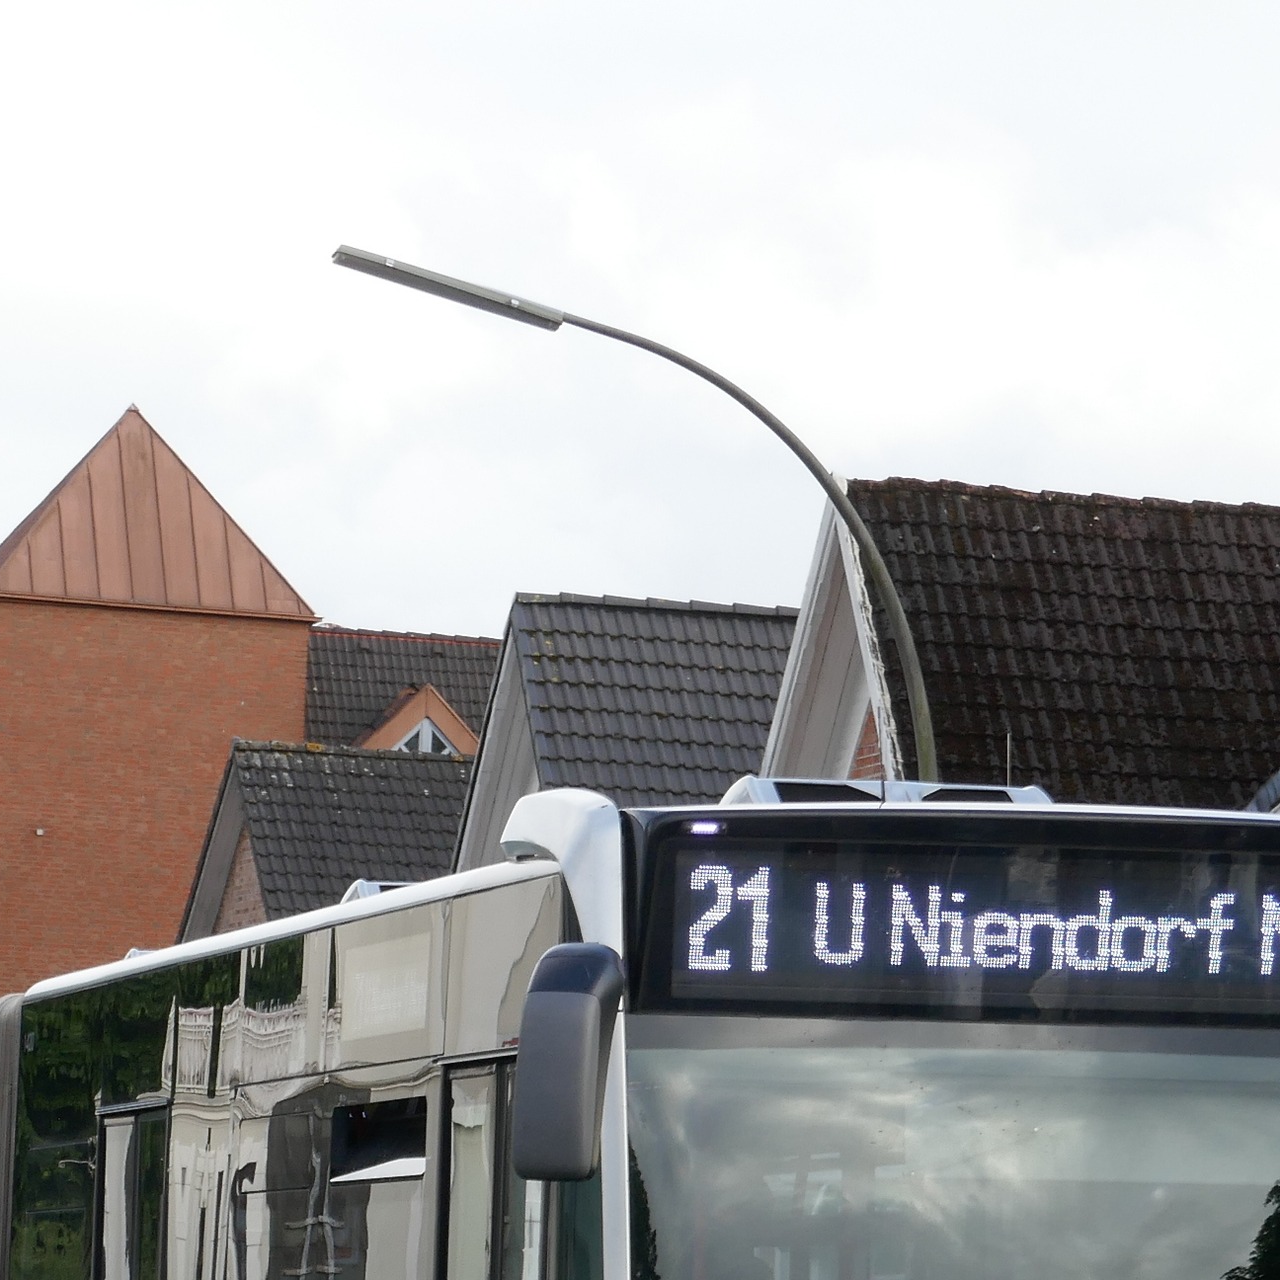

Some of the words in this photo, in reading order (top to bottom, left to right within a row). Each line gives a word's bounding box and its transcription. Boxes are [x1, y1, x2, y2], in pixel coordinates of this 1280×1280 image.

[688, 865, 770, 971] 21
[814, 882, 865, 965] U
[890, 884, 1236, 974] Niendorf
